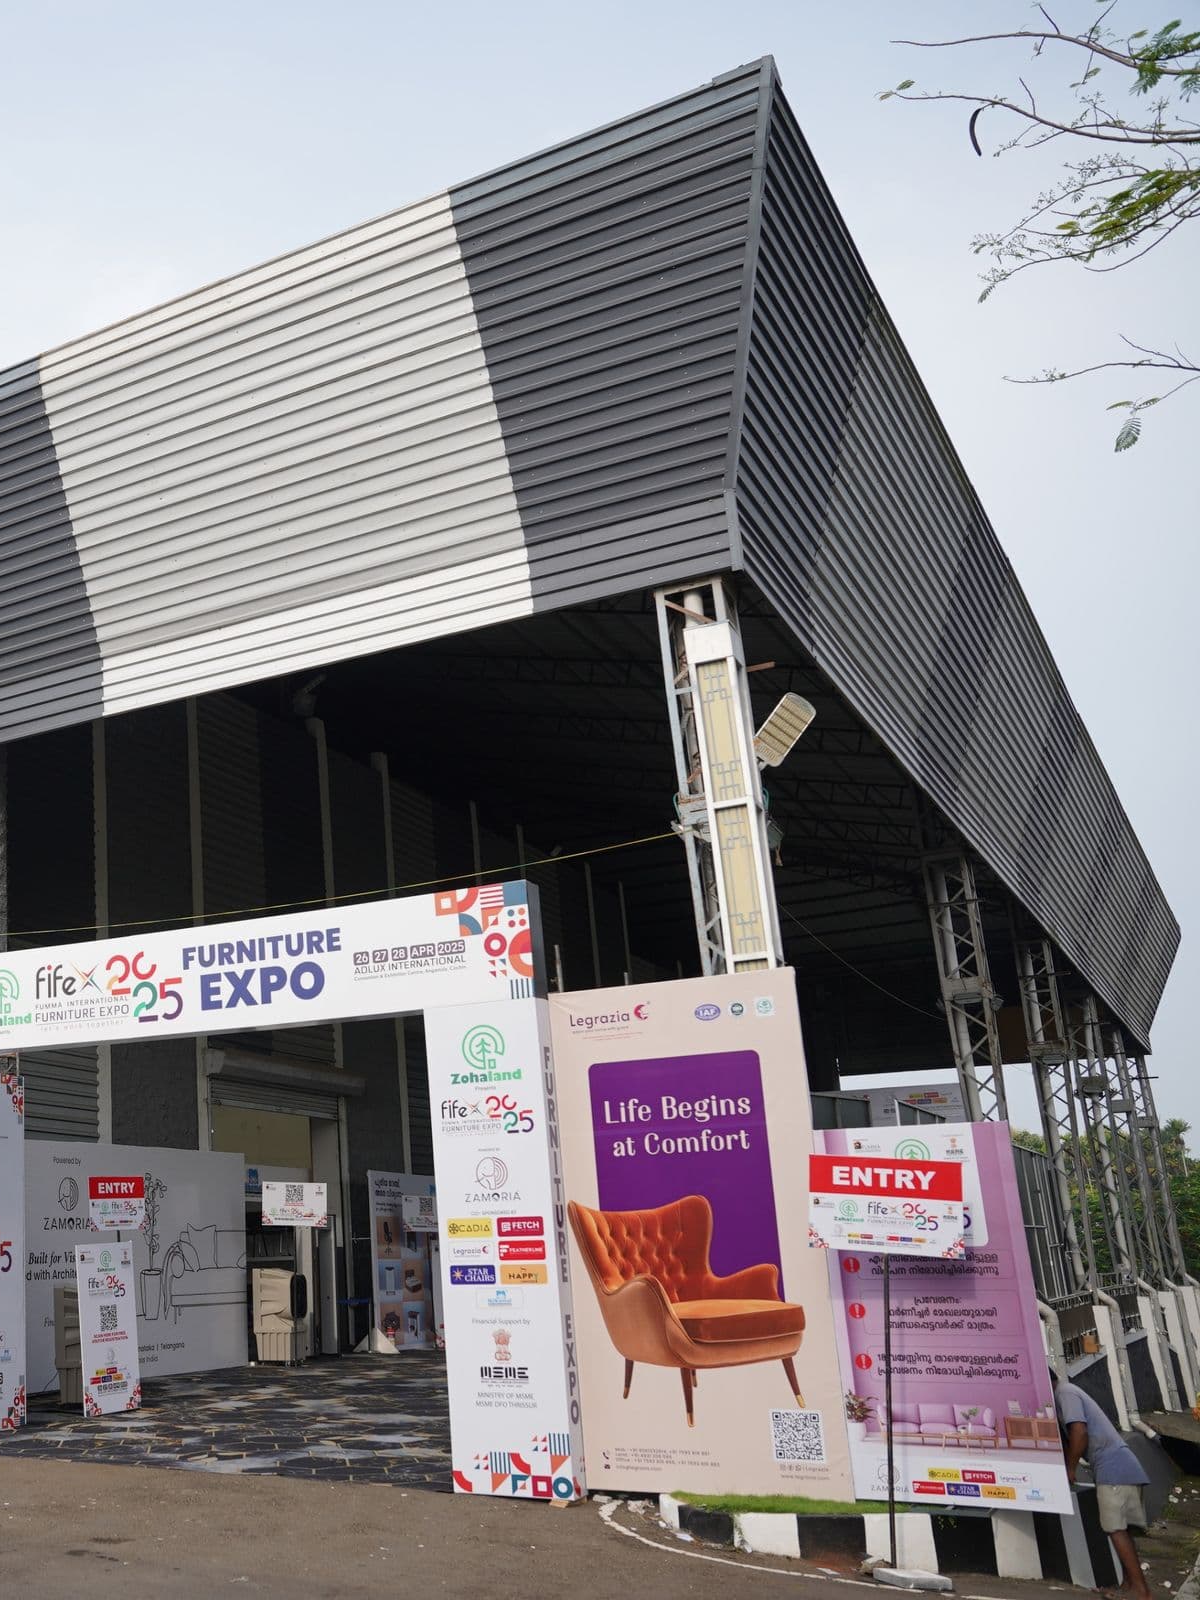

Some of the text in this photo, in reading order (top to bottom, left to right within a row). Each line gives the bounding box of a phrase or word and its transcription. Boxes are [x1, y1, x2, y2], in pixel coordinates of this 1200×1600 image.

[182, 928, 341, 970] FURNITURE
[411, 945, 435, 958] APR
[438, 941, 465, 954] 2025
[354, 955, 467, 975] ADLUX INTERNATIONAL
[200, 961, 325, 1011] EXPO
[35, 995, 129, 1010] FUMMA INTERNATIONAL
[35, 1004, 130, 1023] FURNITURE EXPO
[569, 1011, 630, 1029] Legrazia
[451, 1069, 522, 1085] Zohaland
[604, 1095, 751, 1124] Life Begins
[442, 1125, 480, 1133] FURNITURE
[613, 1129, 750, 1157] at Comfort
[53, 1156, 82, 1166] Powered by
[832, 1165, 936, 1191] ENTRY
[98, 1182, 135, 1194] ENTRY
[465, 1191, 522, 1203] ZAMORIA
[512, 1221, 540, 1229] FETCH
[543, 1047, 579, 1425] FURNITURE EXPO
[453, 1247, 481, 1255] Legrazia
[28, 1251, 62, 1267] Built for
[33, 1269, 51, 1280] with
[464, 1274, 495, 1282] CHAIRS
[498, 1318, 521, 1326] Support
[523, 1318, 531, 1326] by
[160, 1342, 185, 1352] Telangana
[870, 1484, 910, 1493] ZAMRIA
